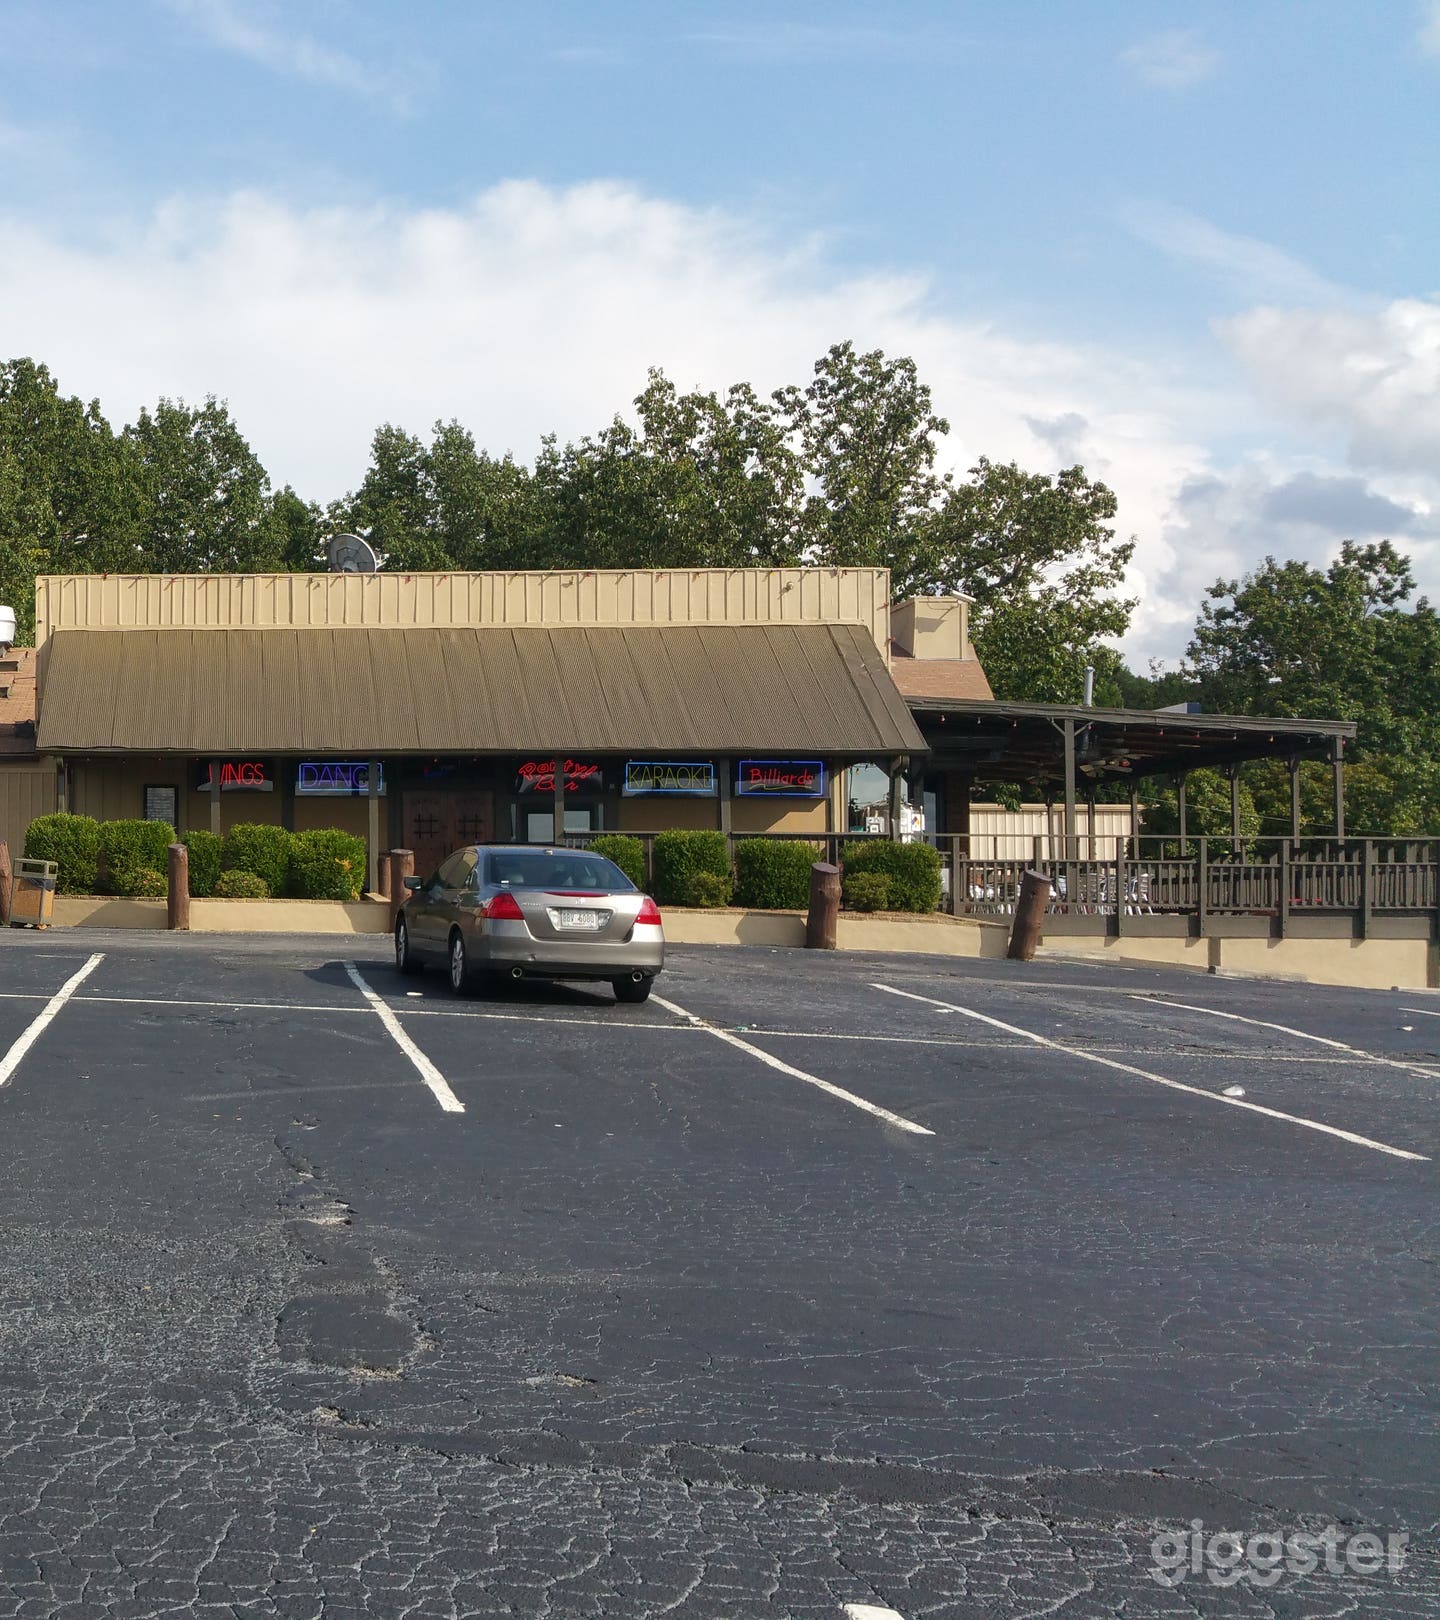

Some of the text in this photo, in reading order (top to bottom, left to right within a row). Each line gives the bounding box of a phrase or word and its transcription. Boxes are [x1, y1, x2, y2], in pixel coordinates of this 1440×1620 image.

[301, 765, 370, 788] DANC
[533, 774, 580, 791] Br
[628, 766, 711, 789] KARAOKE
[749, 768, 813, 785] Billiards
